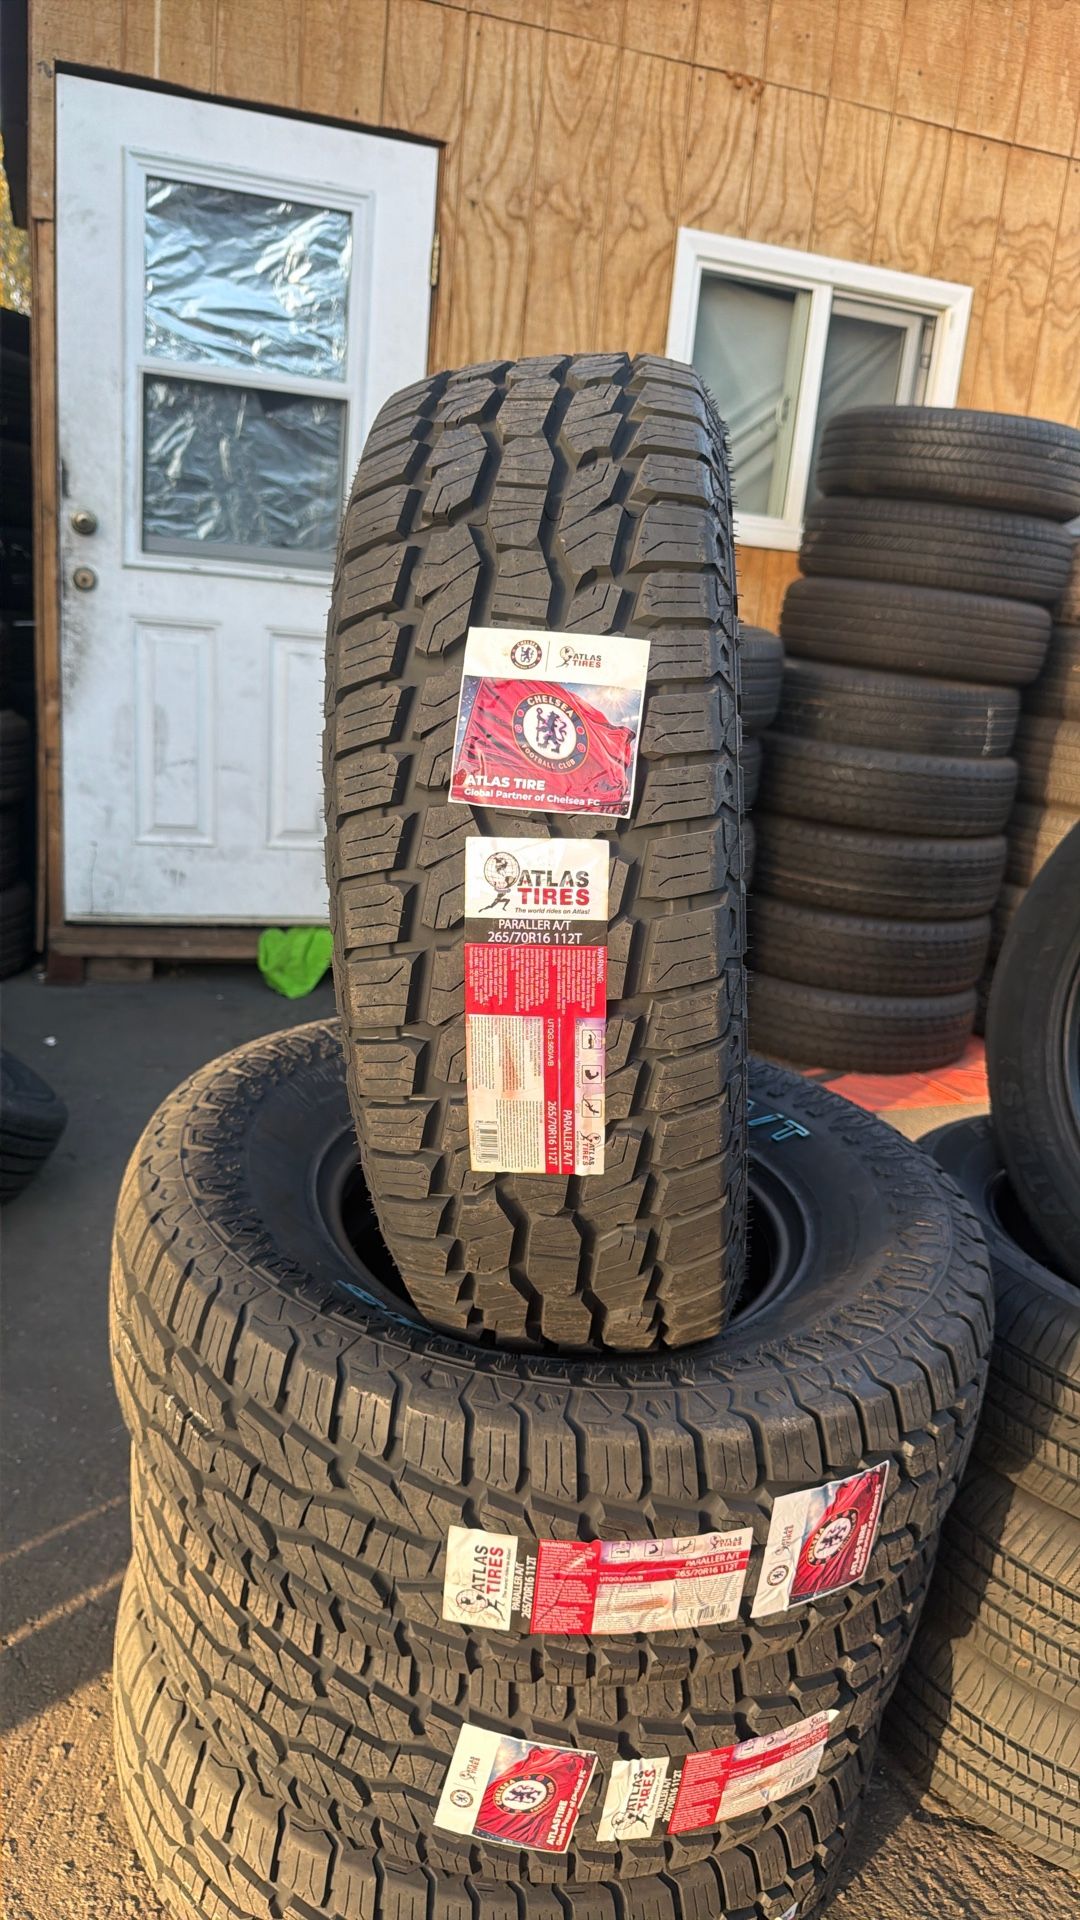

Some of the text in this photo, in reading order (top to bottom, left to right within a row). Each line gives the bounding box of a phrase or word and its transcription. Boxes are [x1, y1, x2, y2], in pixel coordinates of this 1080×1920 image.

[572, 660, 601, 668] TIRES
[573, 653, 601, 661] ATLAS
[527, 695, 574, 718] CHELSEA
[521, 744, 576, 770] FOOTBALL CLUB
[465, 774, 545, 791] ATLAS TIRE
[464, 788, 601, 807] Global Partner of Chelsea FC
[517, 870, 589, 888] ATLAS
[517, 888, 590, 906] TIRES
[498, 919, 571, 931] PARALLER A/T
[487, 931, 583, 945] 265/70R16 112T
[547, 1100, 558, 1166] 265/70R16 112T
[563, 1109, 573, 1166] PARALLER A/T
[472, 1544, 488, 1594] ATLAS
[685, 1551, 740, 1566] PARALLER A/T
[850, 1544, 862, 1576] ATLAS
[486, 1546, 504, 1595] TIRES
[675, 1564, 738, 1578] 265/70R16 112T
[511, 1562, 525, 1611] PARALLER A/T
[521, 1555, 537, 1619] 265/70R16 112T
[579, 1770, 586, 1778] FC
[671, 1770, 682, 1787] 112T
[626, 1771, 643, 1811] ATLAS
[637, 1768, 656, 1811] TIRES
[547, 1800, 568, 1845] ATLAS TIRE
